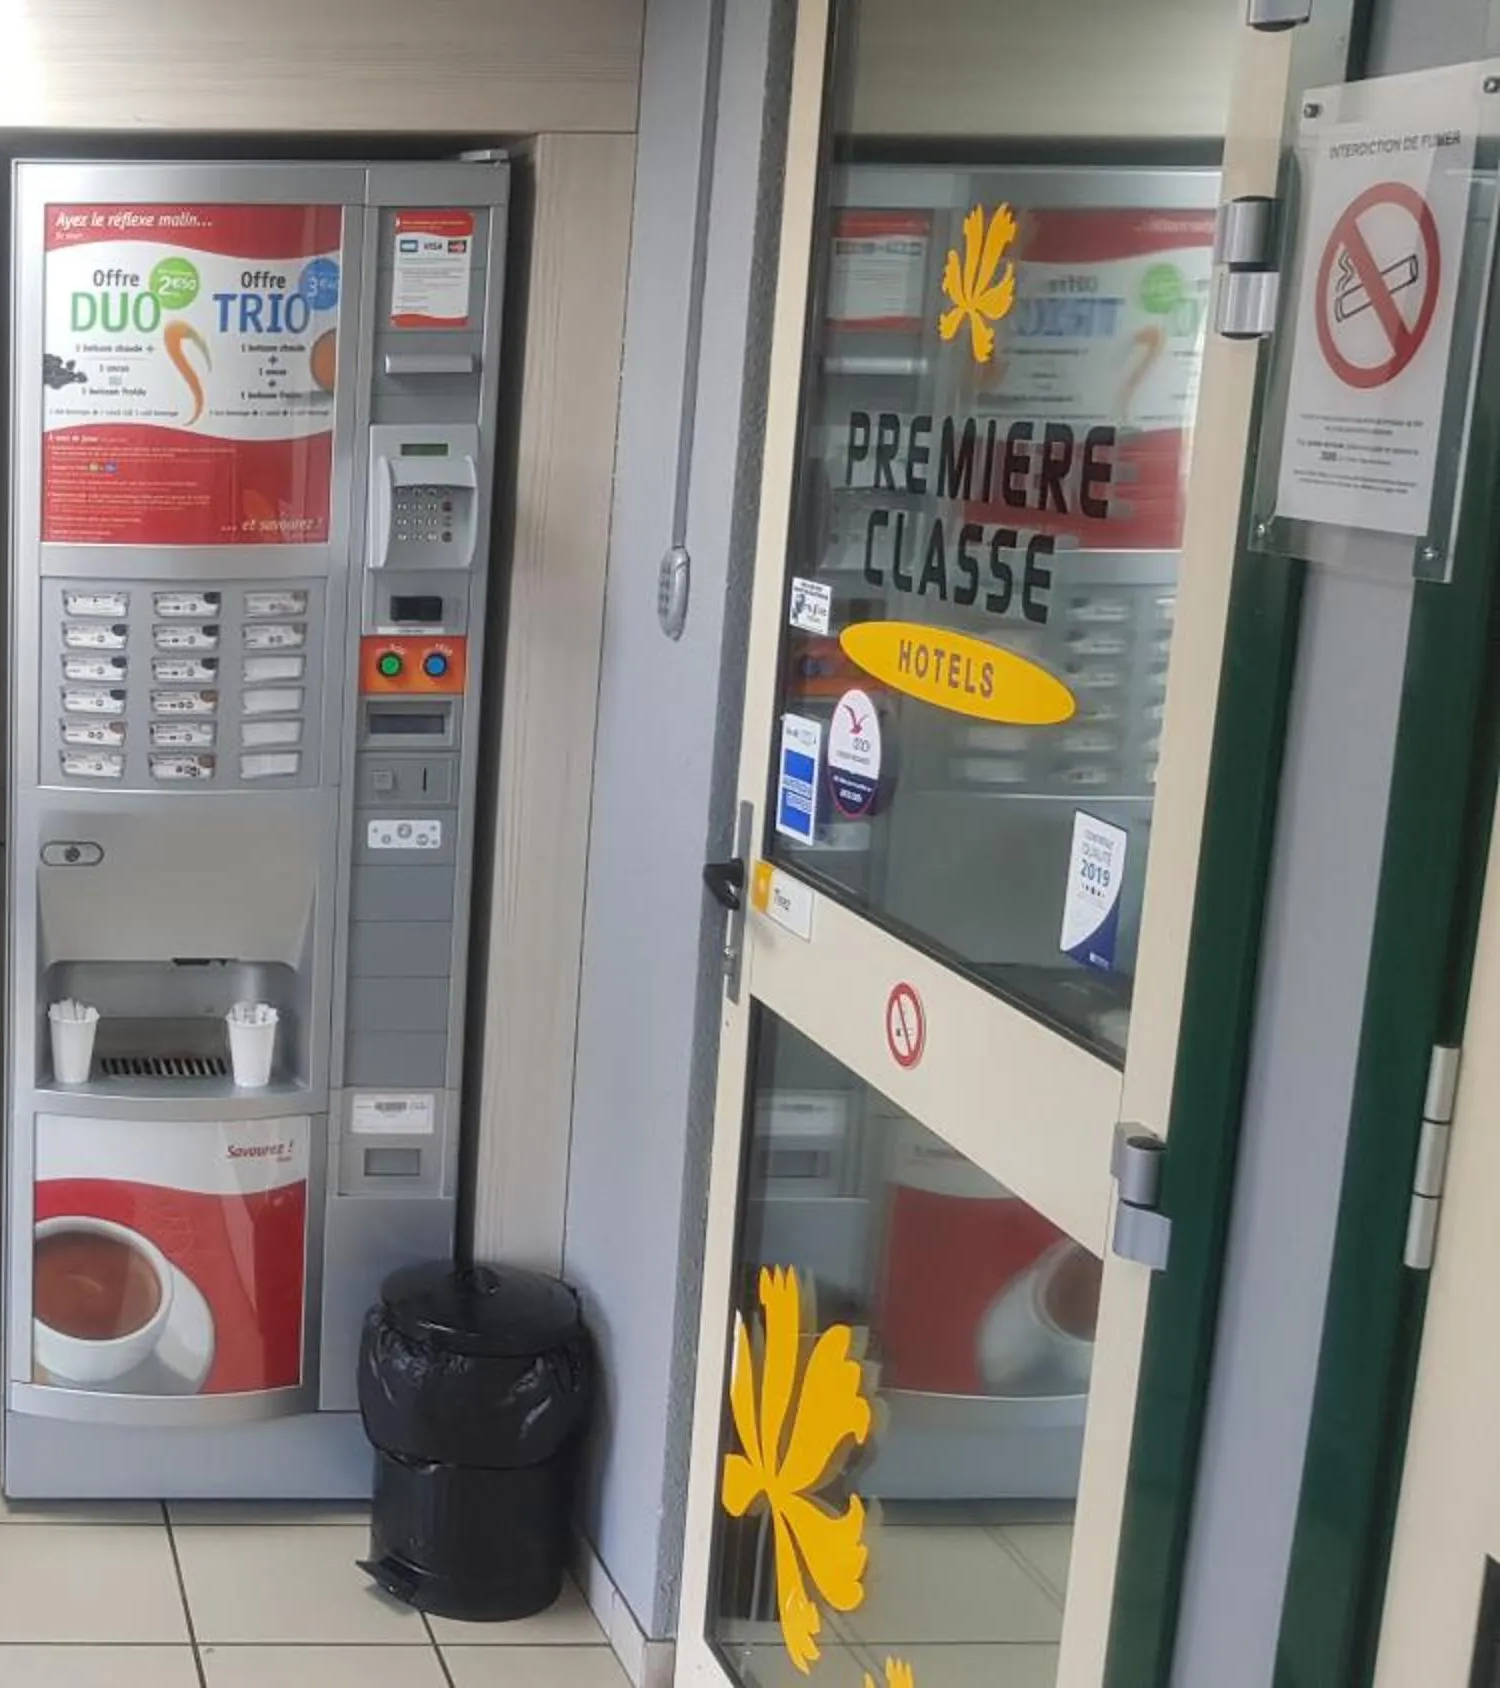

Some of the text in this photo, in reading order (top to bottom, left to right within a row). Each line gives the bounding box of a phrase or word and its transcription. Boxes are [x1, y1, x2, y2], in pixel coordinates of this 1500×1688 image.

[1329, 138, 1401, 160] INTERDICTION
[1403, 135, 1419, 151] DE
[55, 212, 87, 230] Ayez
[91, 213, 105, 227] le
[107, 211, 154, 230] réflexe
[93, 269, 140, 287] Offre
[241, 271, 287, 289] Offre
[70, 291, 161, 333] DUO
[212, 293, 310, 334] TRIO
[845, 411, 1117, 519] PREMIERE
[864, 509, 1056, 625] CLASSE
[898, 638, 995, 699] HOTELS
[1080, 859, 1111, 888] 2019
[226, 1143, 284, 1159] Savourez
